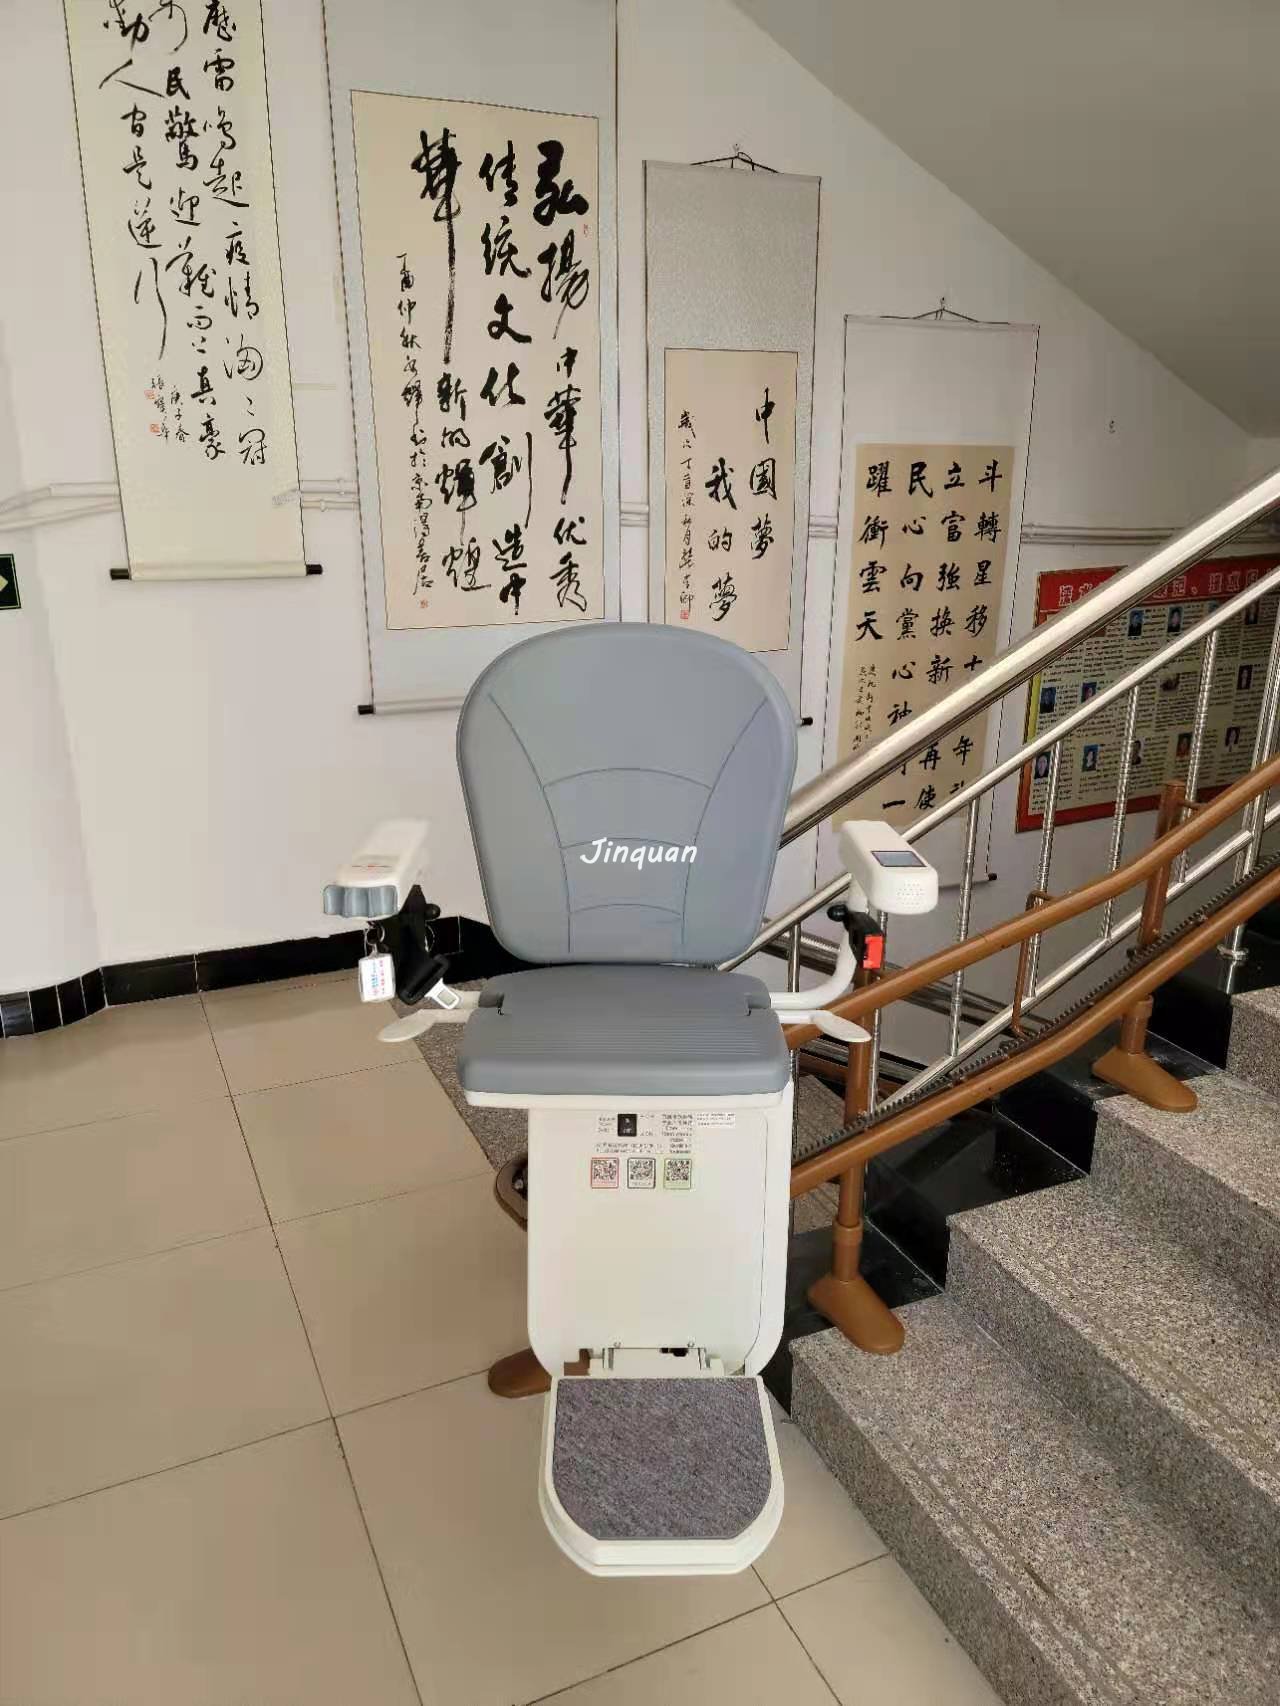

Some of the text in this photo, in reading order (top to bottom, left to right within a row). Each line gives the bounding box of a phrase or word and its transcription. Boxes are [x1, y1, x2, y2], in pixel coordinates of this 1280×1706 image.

[704, 457, 738, 622] 我的夢
[750, 386, 778, 560] 中國夢
